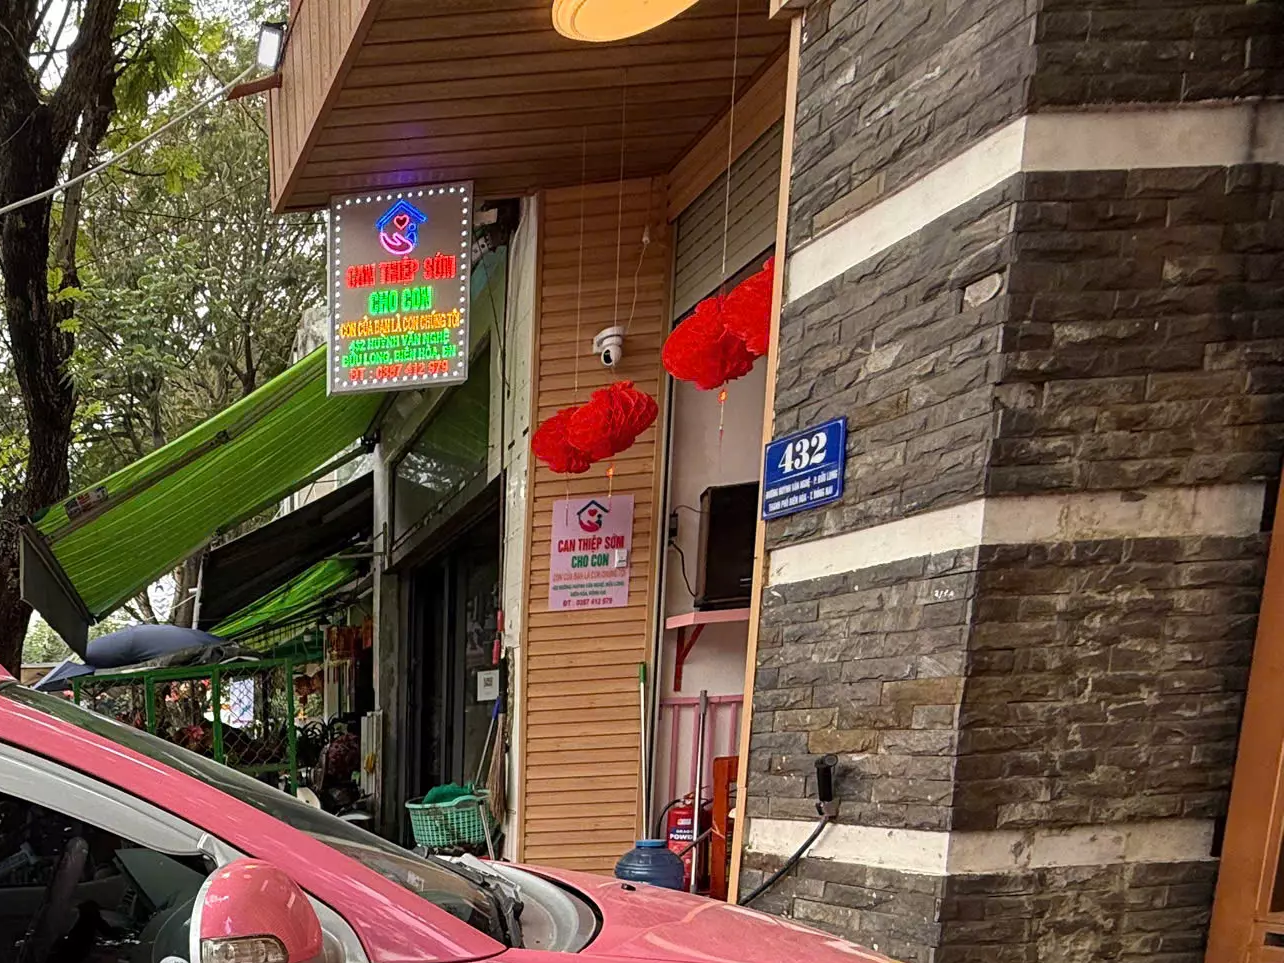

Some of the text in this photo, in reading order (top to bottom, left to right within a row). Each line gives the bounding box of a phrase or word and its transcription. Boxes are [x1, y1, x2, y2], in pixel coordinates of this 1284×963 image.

[346, 252, 456, 288] CAN THIỆP SỚM
[369, 286, 432, 316] CHO CON
[340, 322, 357, 338] CON
[402, 316, 418, 331] CON
[401, 331, 421, 346] VĂN
[778, 432, 827, 474] 432
[558, 534, 624, 552] CAN THIỆP SỚM
[571, 553, 610, 568] CHO CON
